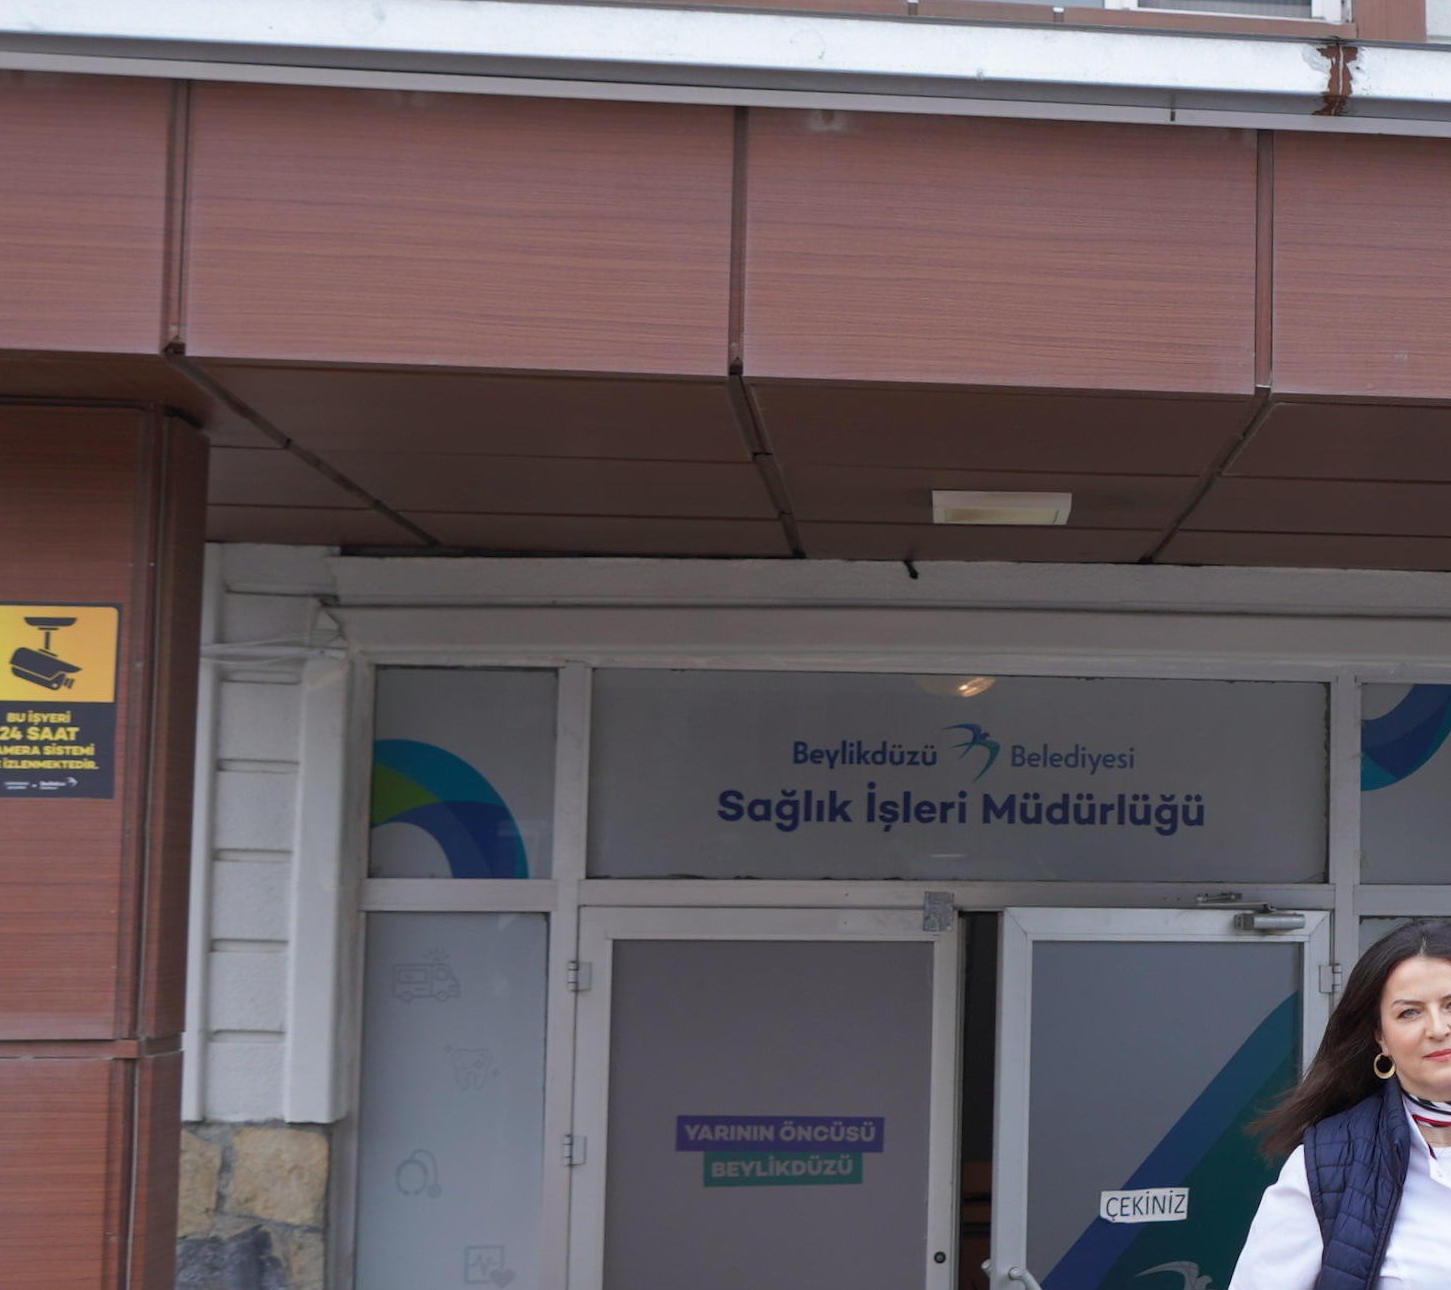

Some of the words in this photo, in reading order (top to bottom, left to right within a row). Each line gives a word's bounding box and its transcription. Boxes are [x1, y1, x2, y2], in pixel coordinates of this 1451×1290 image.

[6, 712, 26, 723] BU
[28, 710, 71, 725] İŞYERİ
[26, 726, 80, 741] SAAT
[43, 743, 95, 756] SİSTEMİ
[793, 740, 937, 769] Beylikdüzü
[1011, 744, 1135, 774] Belediyesi
[717, 790, 852, 832] Sağlık
[866, 782, 967, 832] İşleri
[981, 792, 1205, 836] Müdürlüğü
[685, 1124, 774, 1141] YARININ
[780, 1120, 876, 1142] ÖNCÜSÜ
[711, 1155, 853, 1177] BEYLİKDÜZÜ
[1106, 1190, 1186, 1222] ÇEKİNİZ
